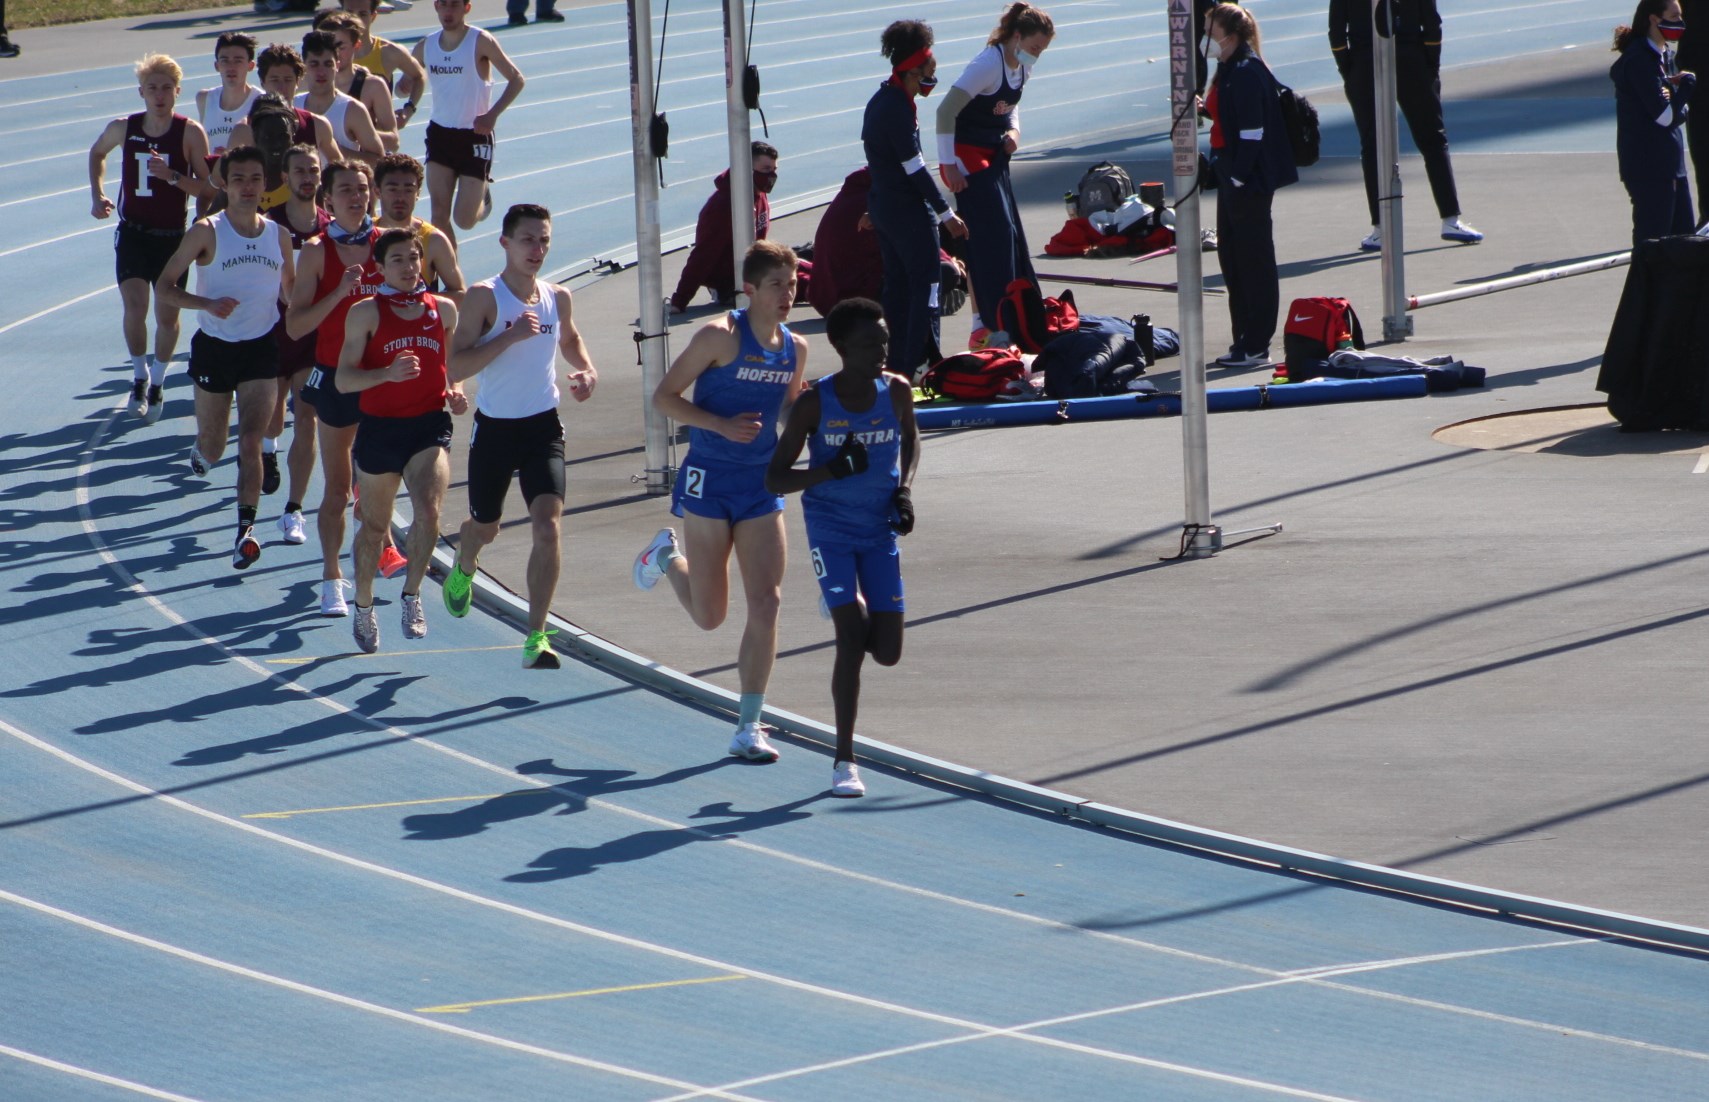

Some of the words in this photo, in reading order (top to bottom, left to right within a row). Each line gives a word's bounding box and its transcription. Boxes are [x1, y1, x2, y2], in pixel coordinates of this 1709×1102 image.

[430, 65, 463, 75] MOLLOY
[1170, 15, 1190, 116] WARNING
[475, 145, 489, 158] 17
[222, 255, 279, 271] MANHATTAN
[383, 336, 414, 354] STONY
[416, 336, 441, 354] BROOK
[824, 429, 894, 446] HOSTRA
[687, 469, 702, 496] 2
[811, 550, 823, 577] 6
